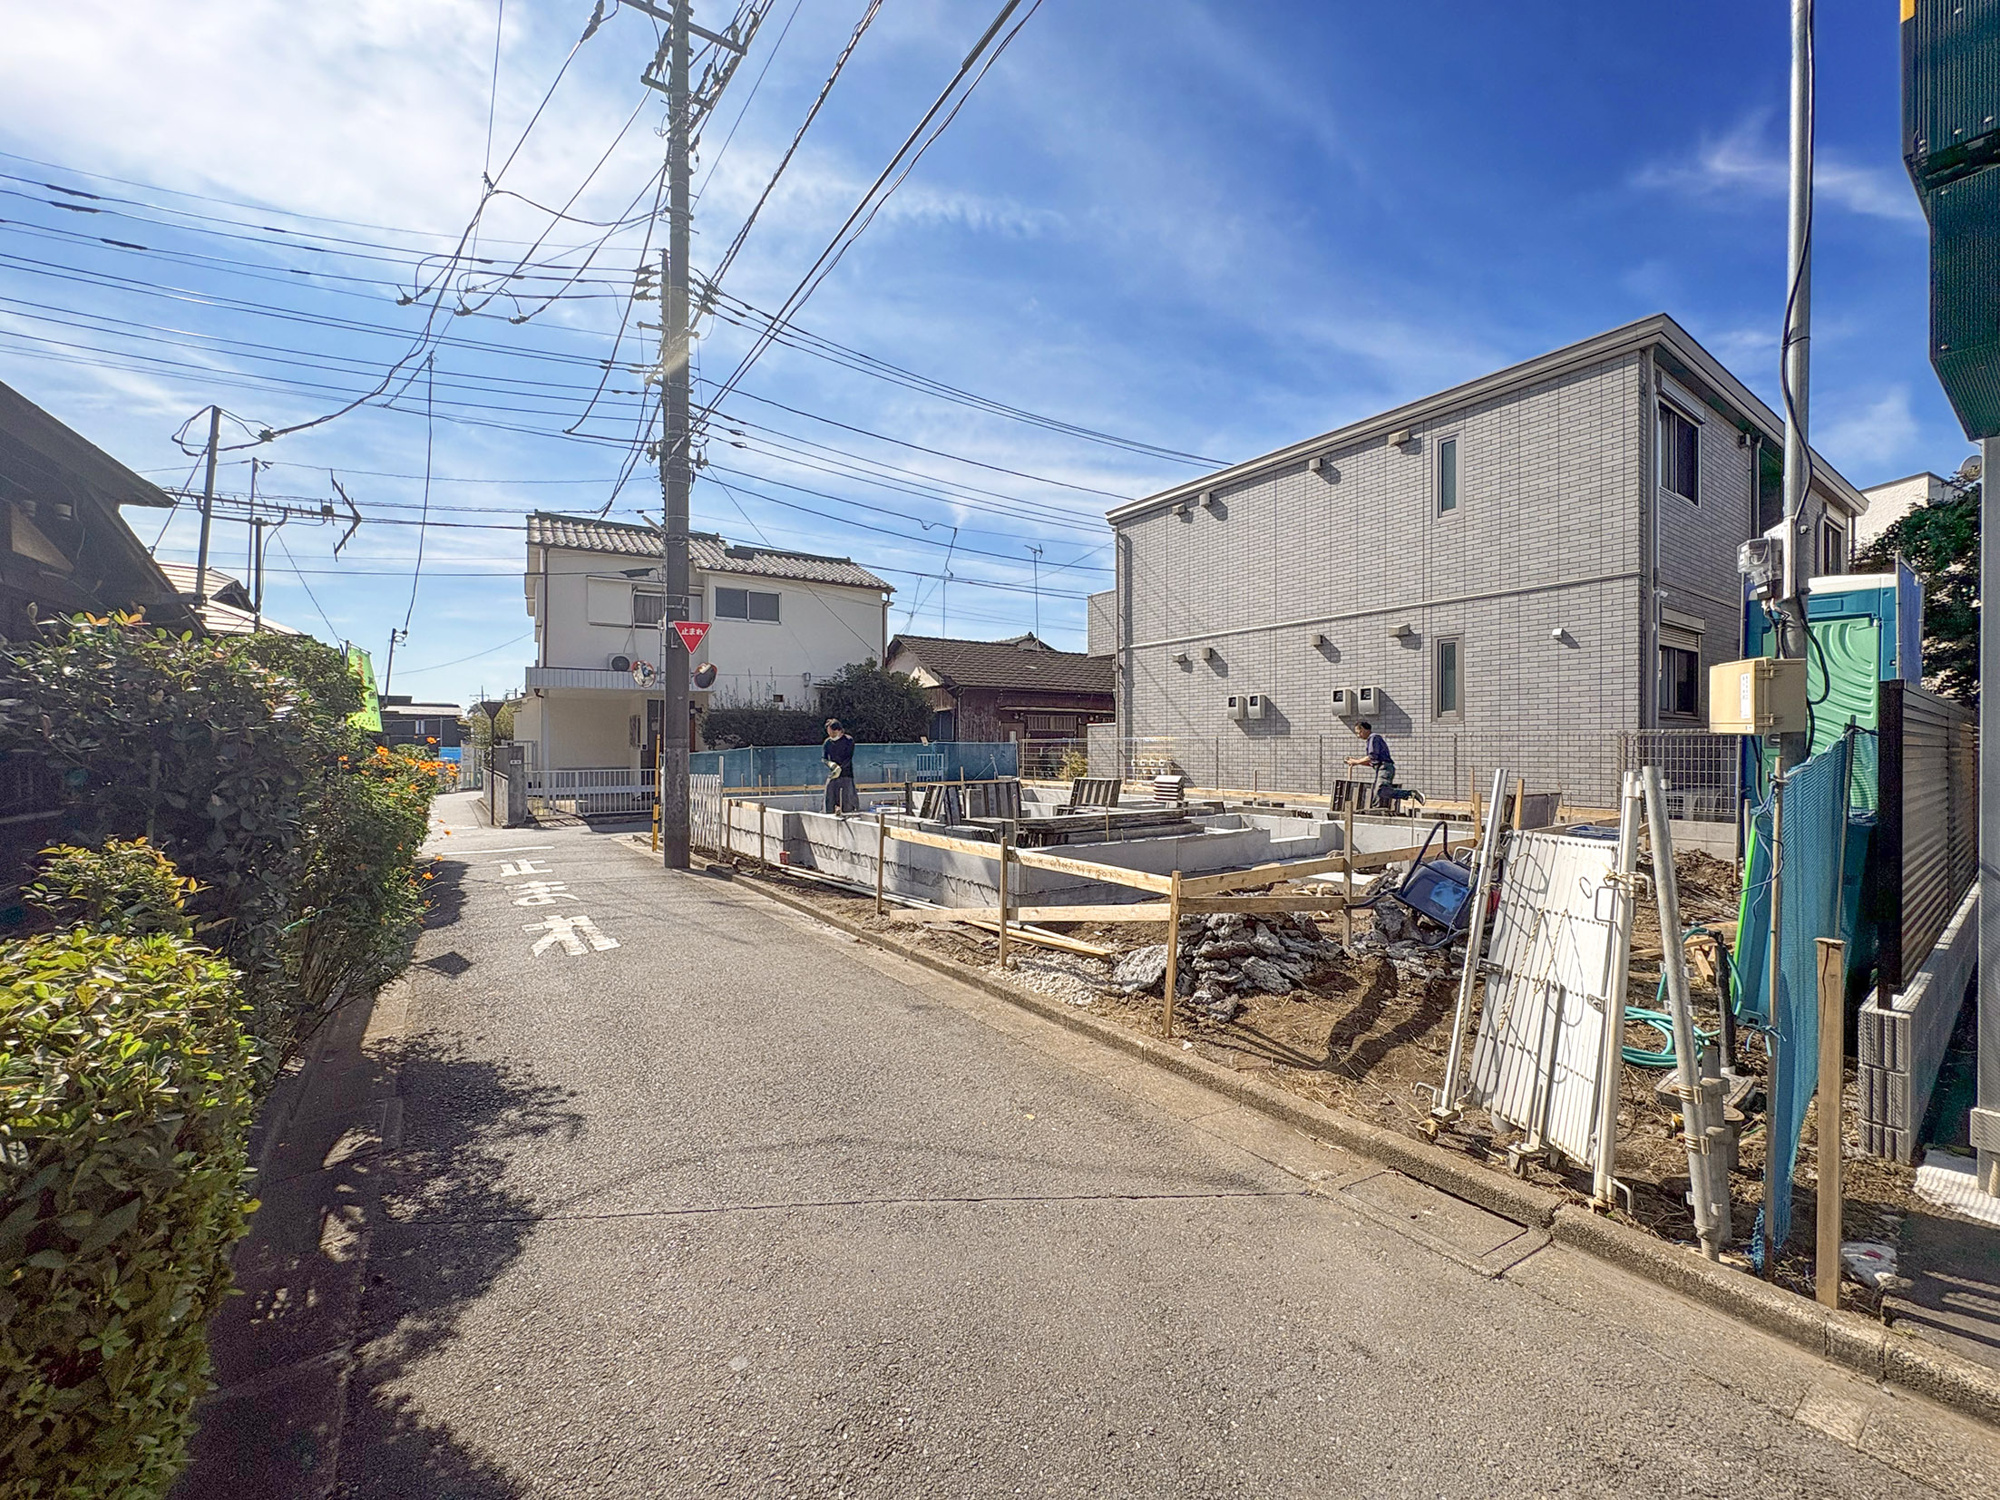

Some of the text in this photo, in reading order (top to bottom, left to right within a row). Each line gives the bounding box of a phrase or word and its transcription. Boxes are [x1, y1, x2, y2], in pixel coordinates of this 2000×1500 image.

[681, 627, 704, 636] 止まれ
[495, 858, 622, 957] 止まれ
